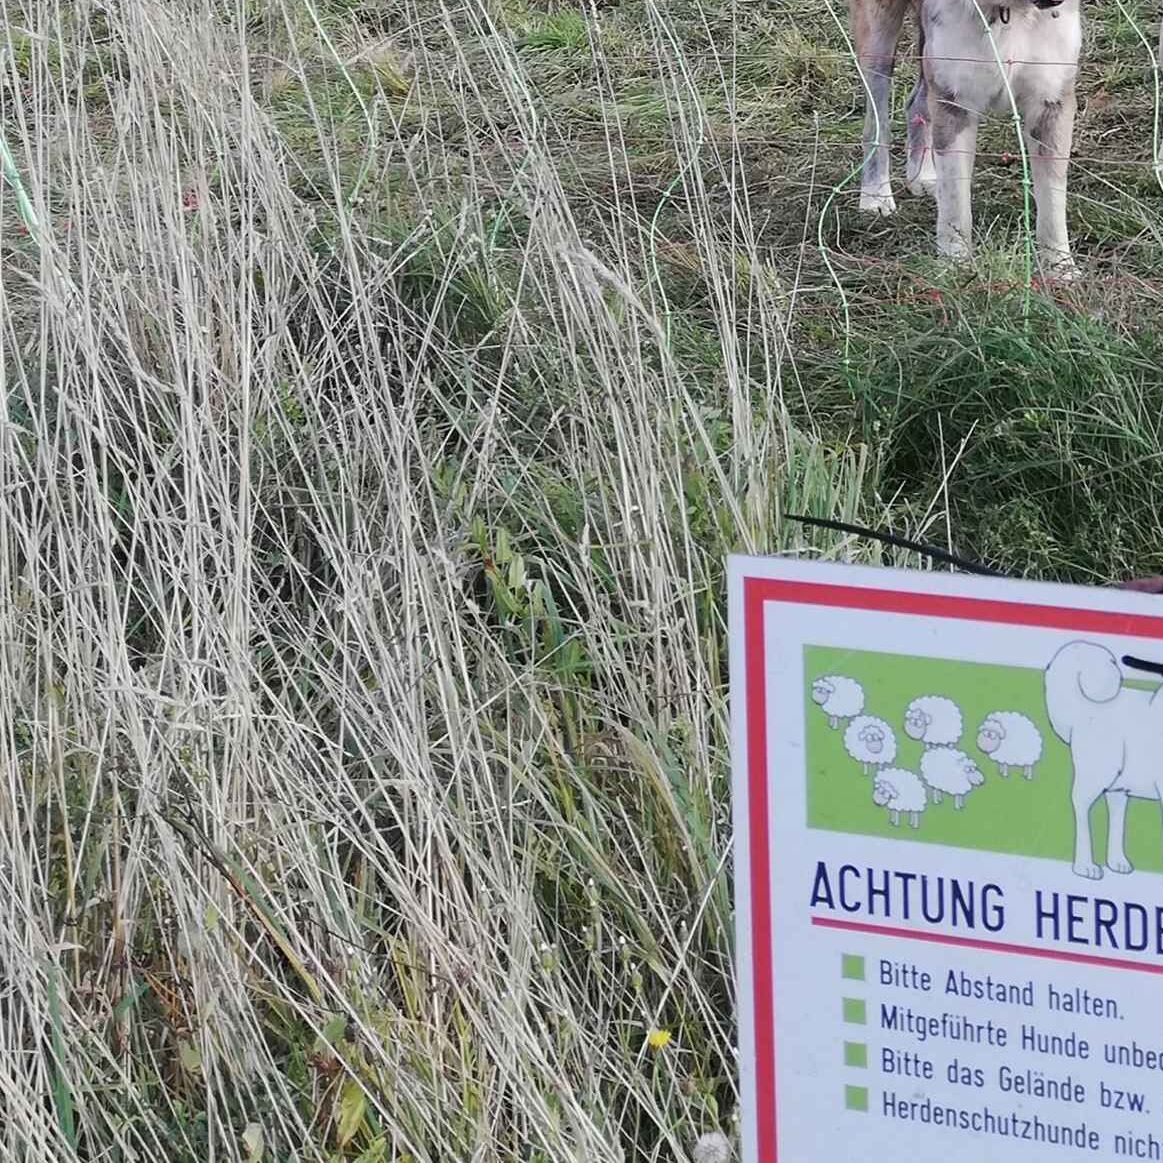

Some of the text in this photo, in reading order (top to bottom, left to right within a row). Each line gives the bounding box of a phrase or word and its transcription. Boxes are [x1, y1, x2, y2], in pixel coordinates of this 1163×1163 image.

[809, 861, 1006, 933] ACHTUNG
[880, 959, 1125, 1020] Bitte Abstand halten.
[880, 1003, 1008, 1047] Mitgeführte
[1021, 1024, 1090, 1059] Hunde
[881, 1047, 934, 1080] Bitte
[947, 1058, 985, 1088] das
[998, 1065, 1086, 1103] Gelände
[1099, 1081, 1151, 1114] bzw.
[882, 1090, 1101, 1151] Herdenschutzhunde
